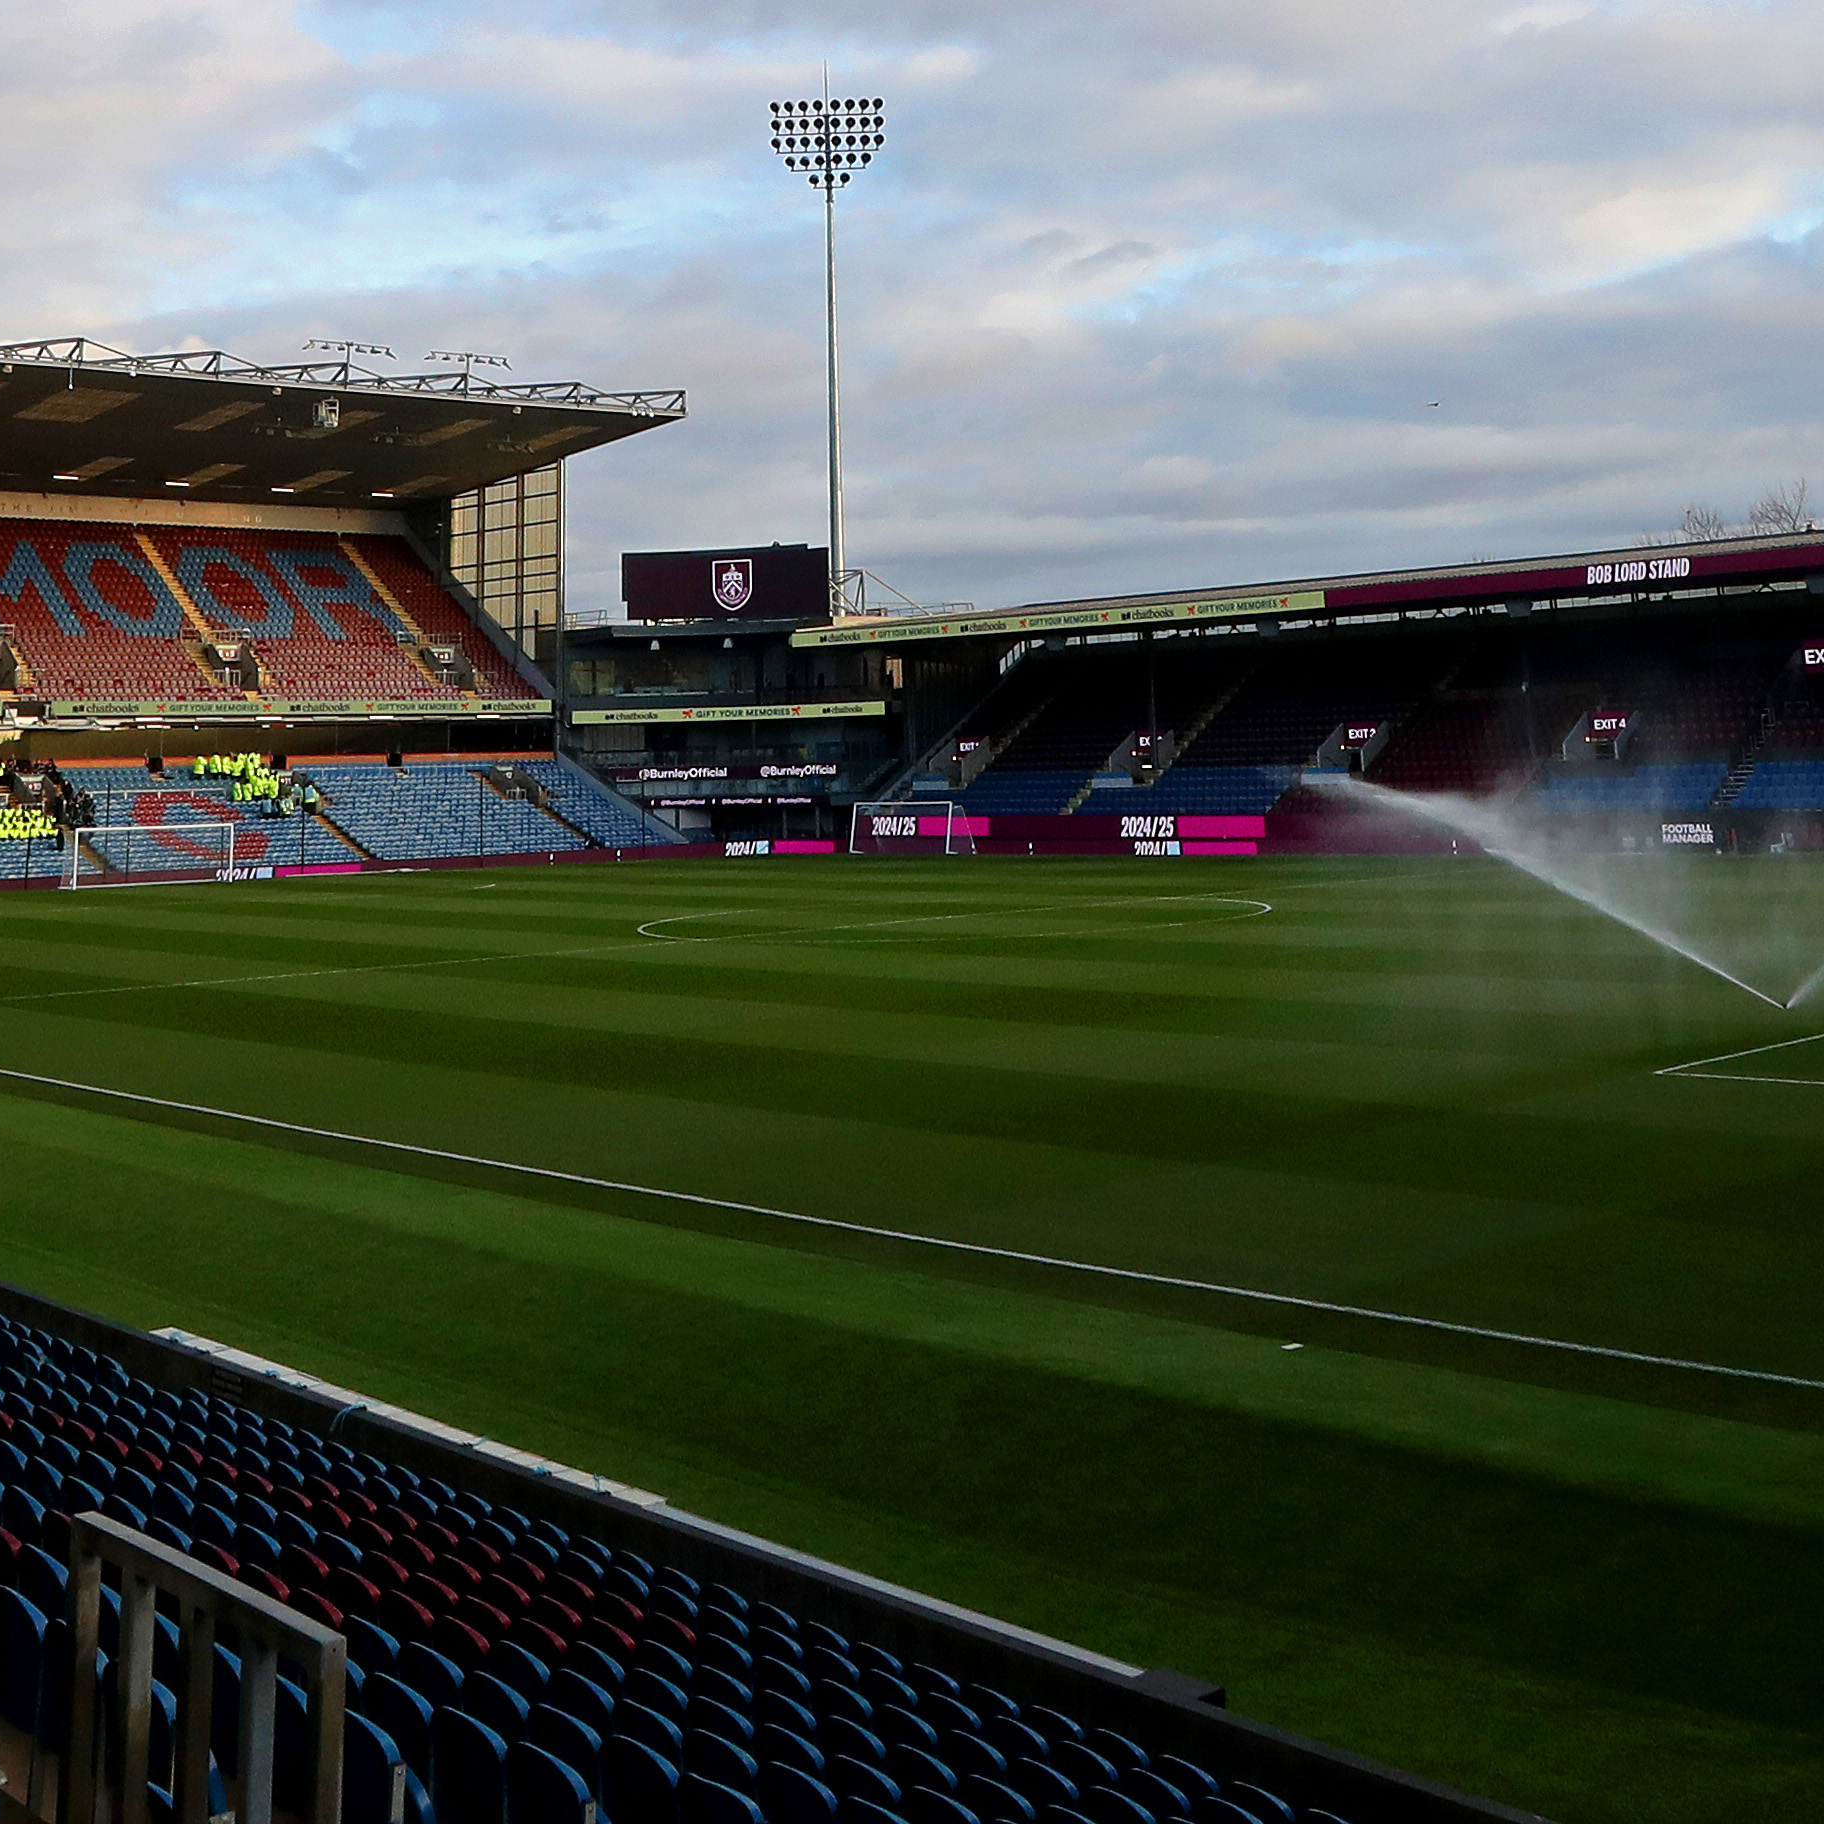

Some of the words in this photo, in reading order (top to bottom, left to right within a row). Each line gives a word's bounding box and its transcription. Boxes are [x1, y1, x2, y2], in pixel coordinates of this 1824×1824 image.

[1587, 564, 1612, 585] BOB
[1614, 561, 1646, 583] LORD
[1648, 557, 1690, 580] STAND
[86, 702, 140, 713] chatbooks
[169, 704, 191, 712] GIFT
[191, 704, 215, 712] YOUR
[215, 704, 260, 712] MEMORIES
[302, 702, 350, 712] chatbooks
[696, 710, 716, 719] GIFT
[720, 709, 743, 718] YOUR
[746, 708, 790, 717] MEMORIES
[1593, 718, 1618, 731] EXIT
[1618, 717, 1626, 728] 4
[1348, 728, 1369, 740] EXIT
[639, 766, 727, 782] @BurnleyOfficial
[760, 764, 836, 778] @BurnleyOfficial
[872, 816, 916, 837] 2024/25
[1121, 815, 1175, 839] 2024/25
[1661, 823, 1714, 834] FOOTBALL
[1662, 833, 1714, 844] MANAGER
